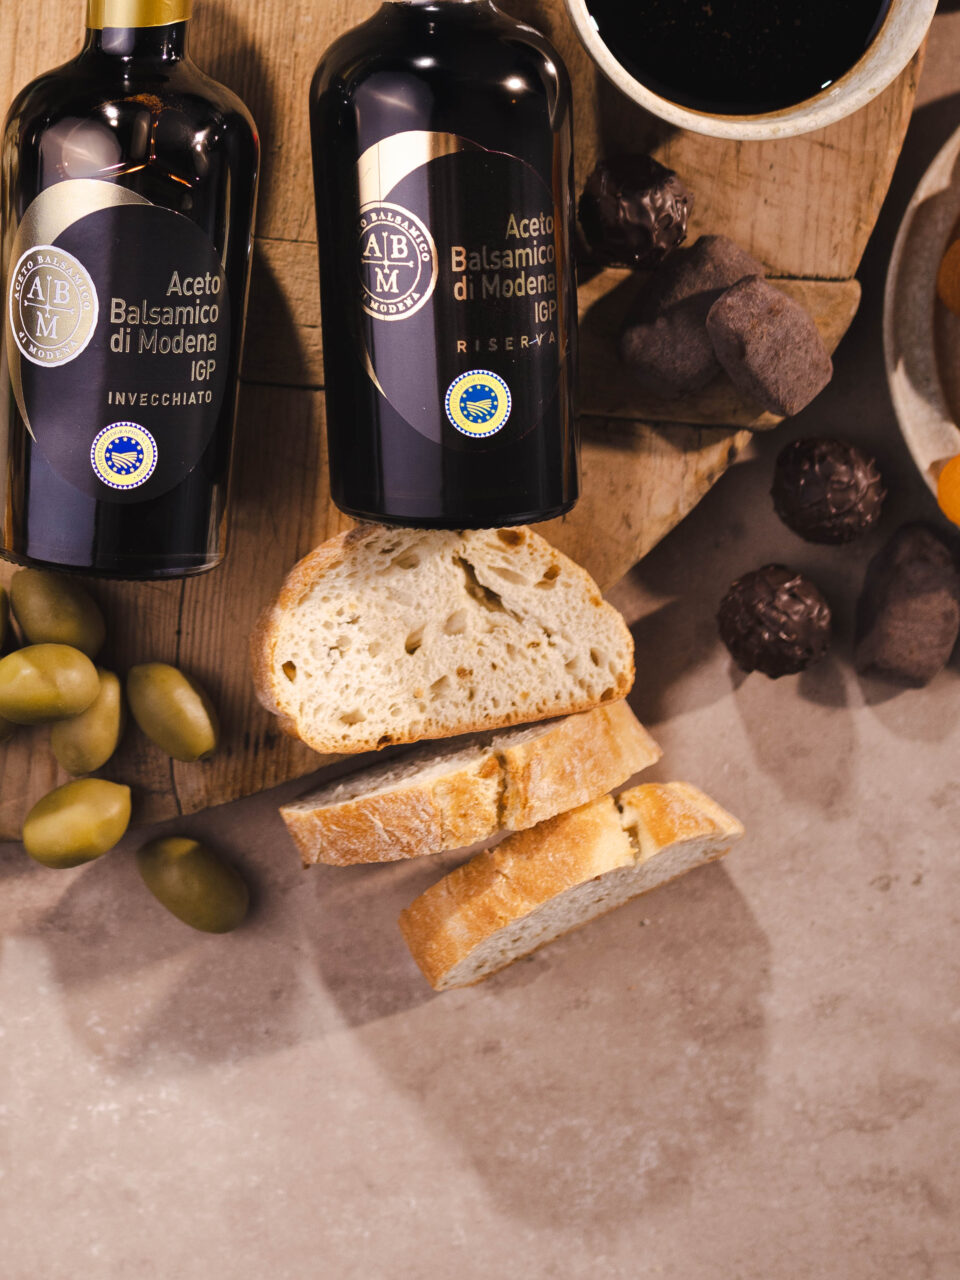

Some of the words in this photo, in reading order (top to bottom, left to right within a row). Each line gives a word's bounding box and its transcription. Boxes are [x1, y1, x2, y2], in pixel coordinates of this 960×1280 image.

[370, 210, 430, 262] BALSAMICO
[506, 212, 553, 240] Aceto
[451, 240, 555, 272] Balsamico
[14, 260, 34, 300] ACETO
[38, 255, 91, 310] BALSAMICO
[166, 270, 221, 296] Aceto
[453, 275, 474, 301] di
[482, 270, 555, 299] Modena
[110, 297, 219, 325] Balsamico
[369, 291, 420, 313] MODENA
[534, 299, 556, 323] IGP
[28, 340, 77, 359] MODENA
[110, 327, 131, 353] di
[138, 328, 217, 354] Modena
[457, 331, 555, 353] RISERVA
[191, 359, 216, 381] IGP
[107, 390, 212, 406] INVECCHIATO
